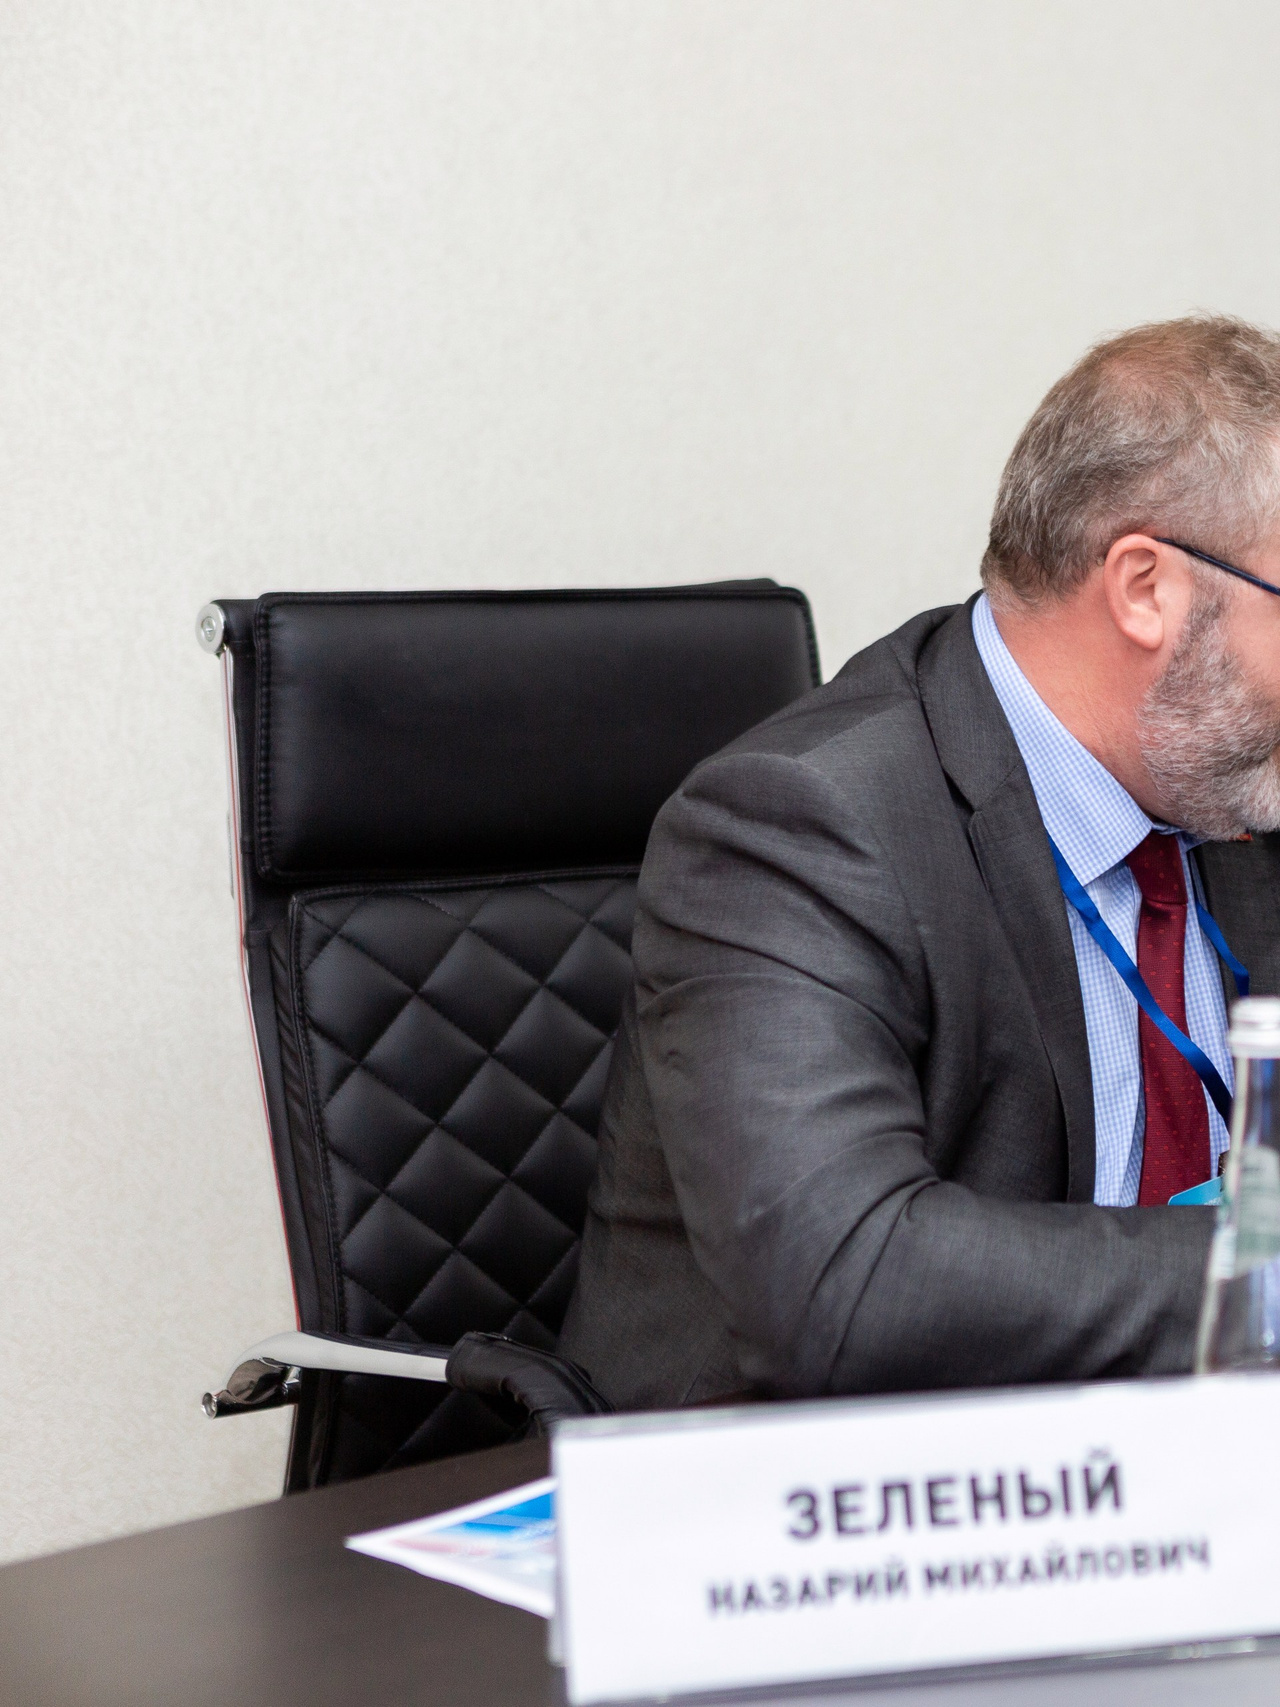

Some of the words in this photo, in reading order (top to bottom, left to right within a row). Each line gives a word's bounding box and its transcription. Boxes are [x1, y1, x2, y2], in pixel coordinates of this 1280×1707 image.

[785, 1447, 1123, 1541] ЗЕЛЕНЫЙ
[707, 1558, 909, 1618] НАЗАРИЙ
[923, 1537, 1211, 1593] МИХАЙЛОВИЧ
